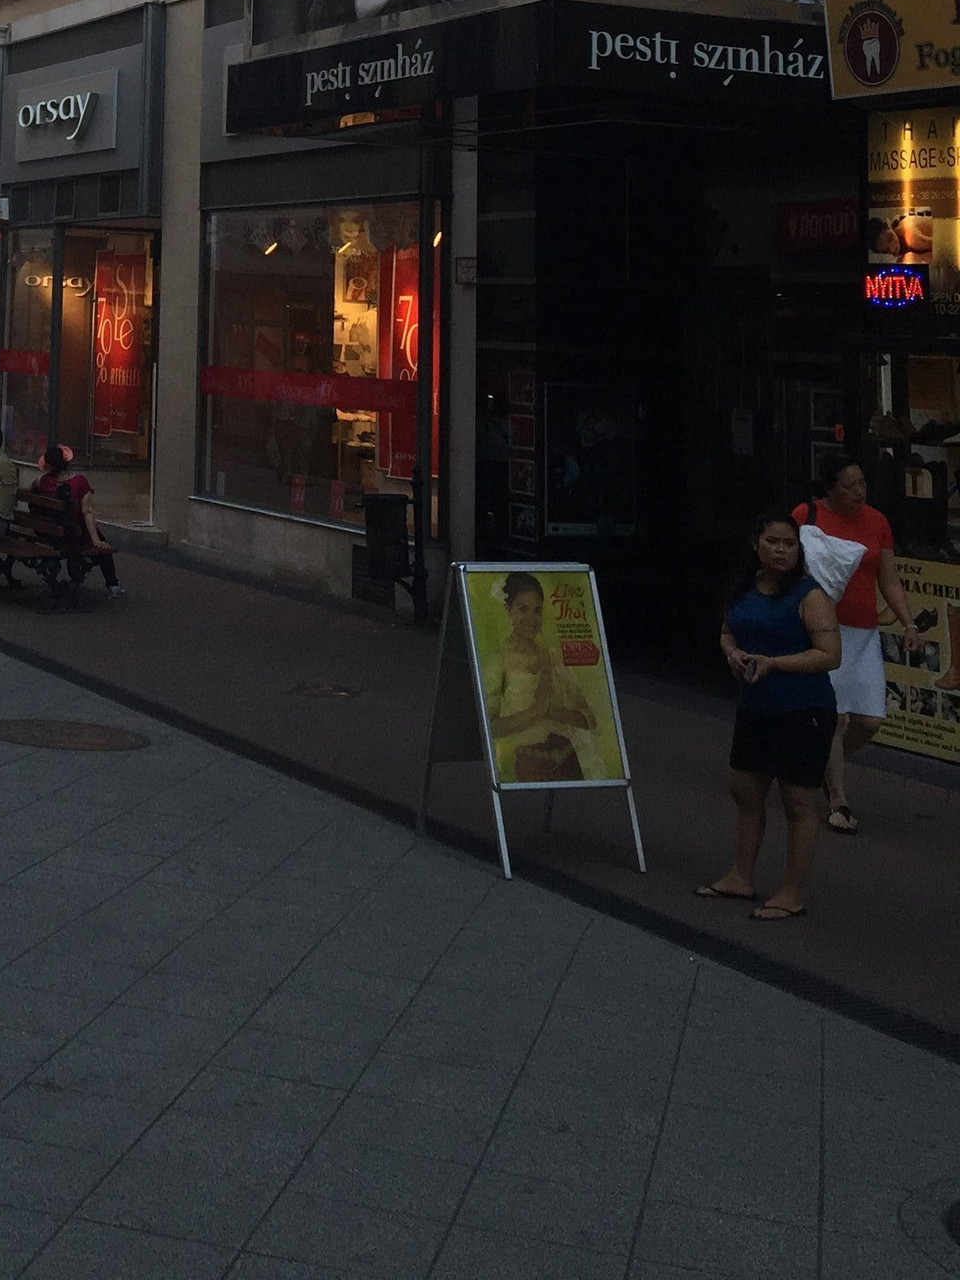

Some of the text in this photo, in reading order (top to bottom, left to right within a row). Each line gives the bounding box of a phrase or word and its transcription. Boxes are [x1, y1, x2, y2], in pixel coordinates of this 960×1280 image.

[587, 29, 680, 80] pesti
[304, 61, 353, 107] pesti
[18, 92, 92, 141] orsay
[864, 274, 924, 301] NYITVA
